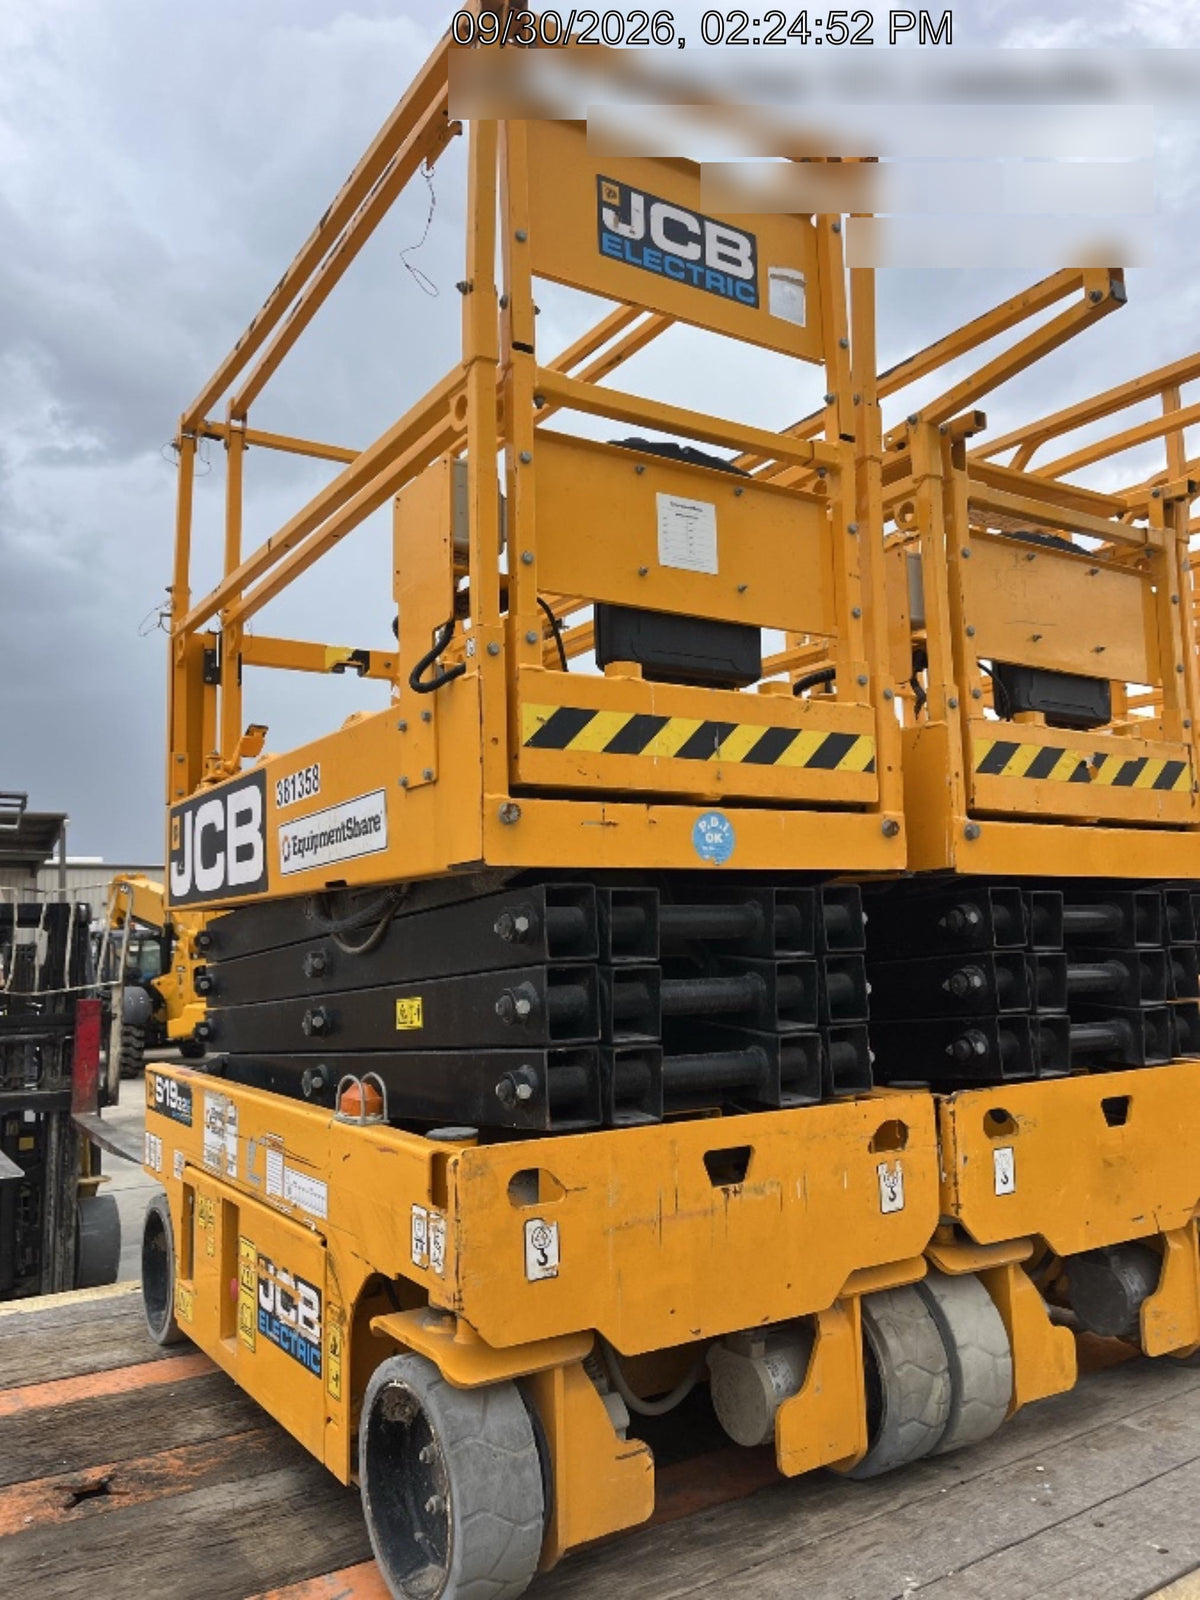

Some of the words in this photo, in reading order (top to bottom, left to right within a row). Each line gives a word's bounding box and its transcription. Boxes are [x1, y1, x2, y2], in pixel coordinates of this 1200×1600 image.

[602, 191, 755, 280] JCB
[602, 232, 756, 304] ELECTRIC
[170, 785, 264, 897] JCB
[291, 811, 382, 860] EquipmentShare
[705, 832, 724, 844] OK
[259, 1263, 321, 1345] JCB
[258, 1311, 321, 1374] ELECTRIC
